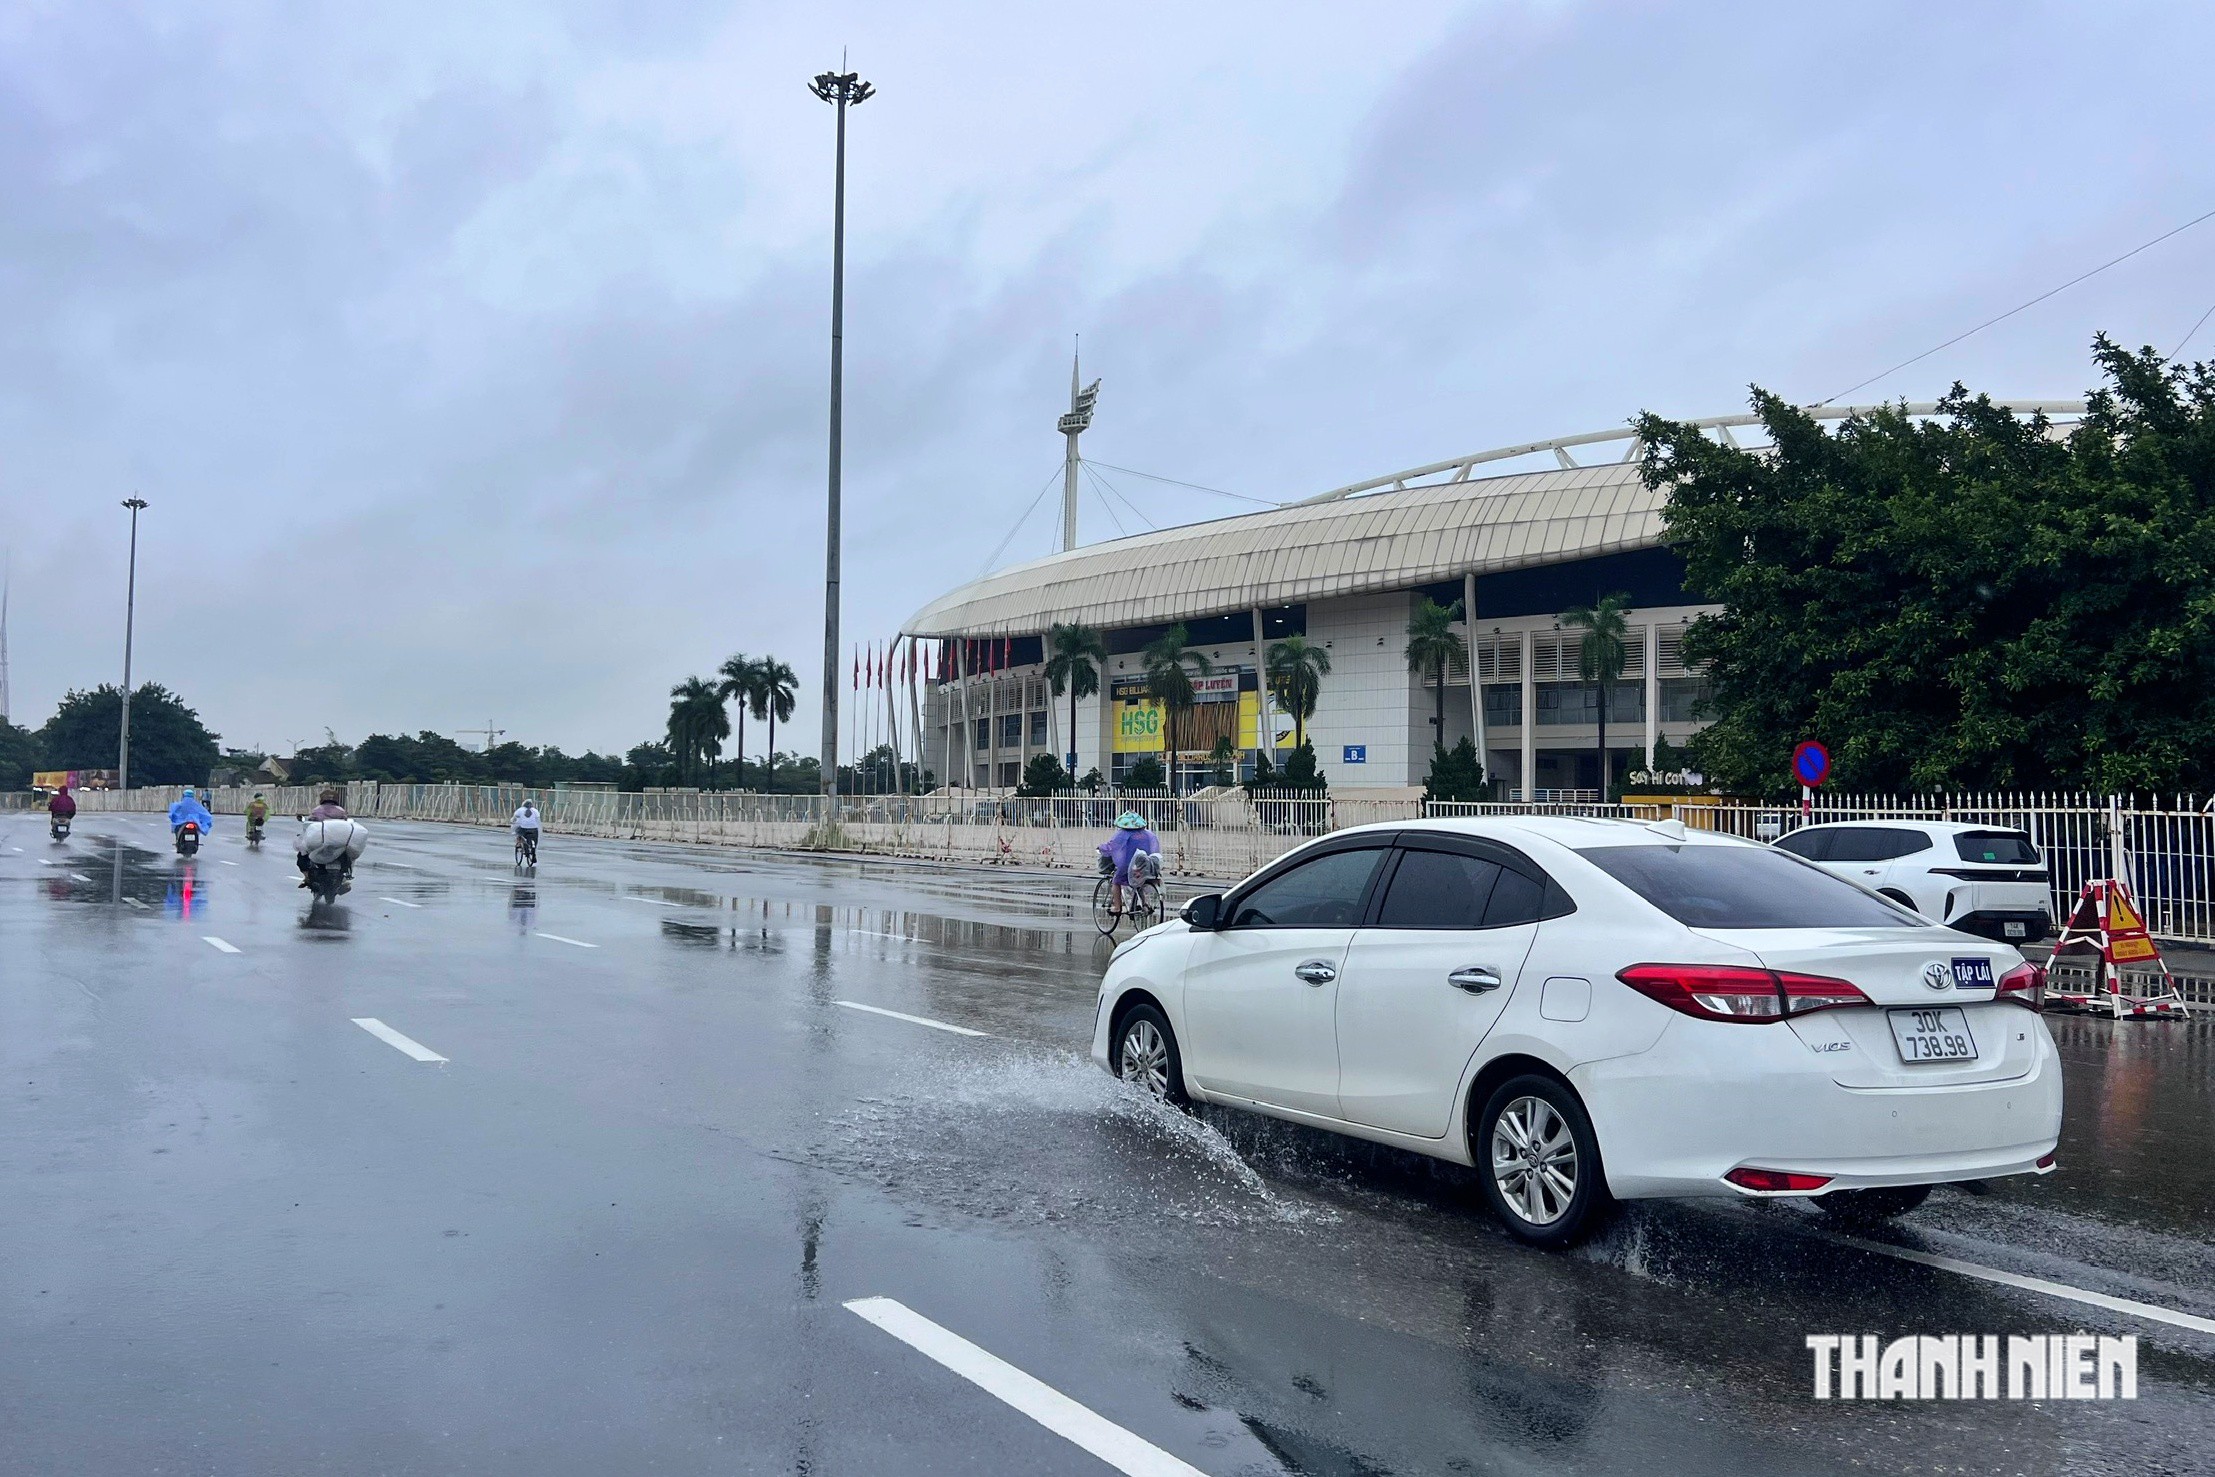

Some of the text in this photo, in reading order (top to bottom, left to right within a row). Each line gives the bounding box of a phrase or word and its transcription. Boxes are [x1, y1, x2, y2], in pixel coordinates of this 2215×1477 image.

[1116, 686, 1128, 696] HSG
[1121, 709, 1158, 735] HSG
[1350, 750, 1358, 760] B
[1955, 962, 1991, 985] TẬP LÁI
[1911, 1011, 1948, 1033] 30K
[1811, 1041, 1851, 1053] VIOS
[1906, 1034, 1968, 1058] 738.98
